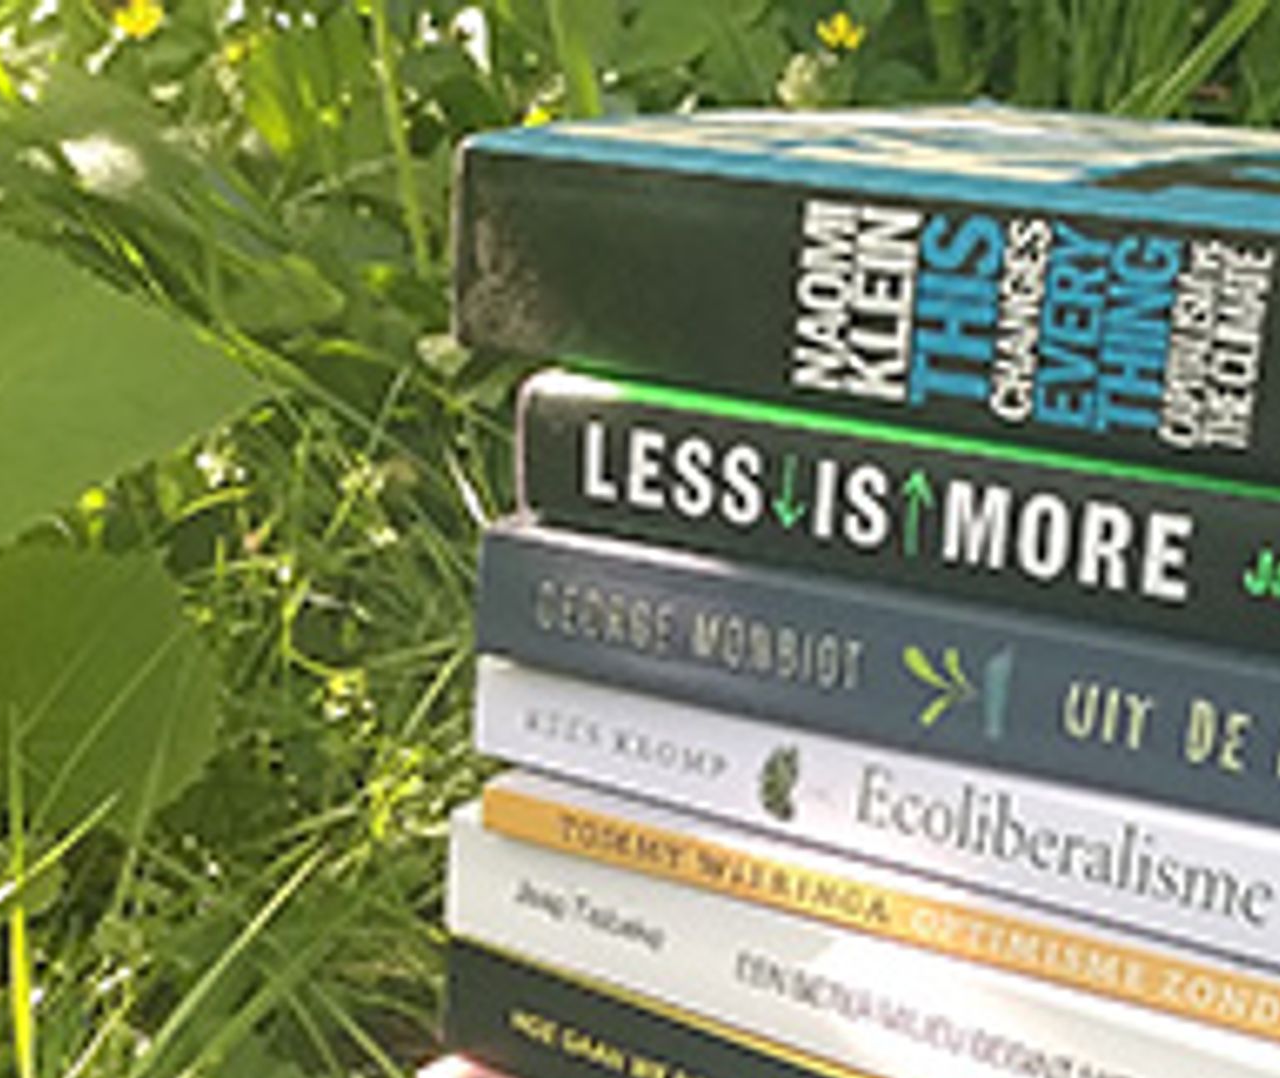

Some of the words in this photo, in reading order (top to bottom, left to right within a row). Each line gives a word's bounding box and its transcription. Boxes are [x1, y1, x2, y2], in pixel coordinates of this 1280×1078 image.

[793, 199, 859, 391] NAOMI
[844, 206, 921, 401] KLEIN
[911, 213, 1004, 406] THIS
[990, 219, 1052, 421] CHANGES
[1034, 221, 1110, 429] EVERY
[1094, 235, 1182, 432] THING
[1200, 390, 1253, 449] THE
[582, 422, 765, 525] LESS
[814, 459, 888, 547] IS
[942, 480, 1195, 600] MORE
[534, 579, 674, 653] GEORGE
[690, 612, 864, 690] MONBIOT
[1063, 681, 1152, 750] UIT
[1184, 699, 1253, 772] DE
[556, 814, 684, 870] TOMMY
[698, 846, 893, 924] WIERINGA
[856, 762, 1274, 927] Ecoliberalisme
[909, 904, 1146, 988] OPTIMISME
